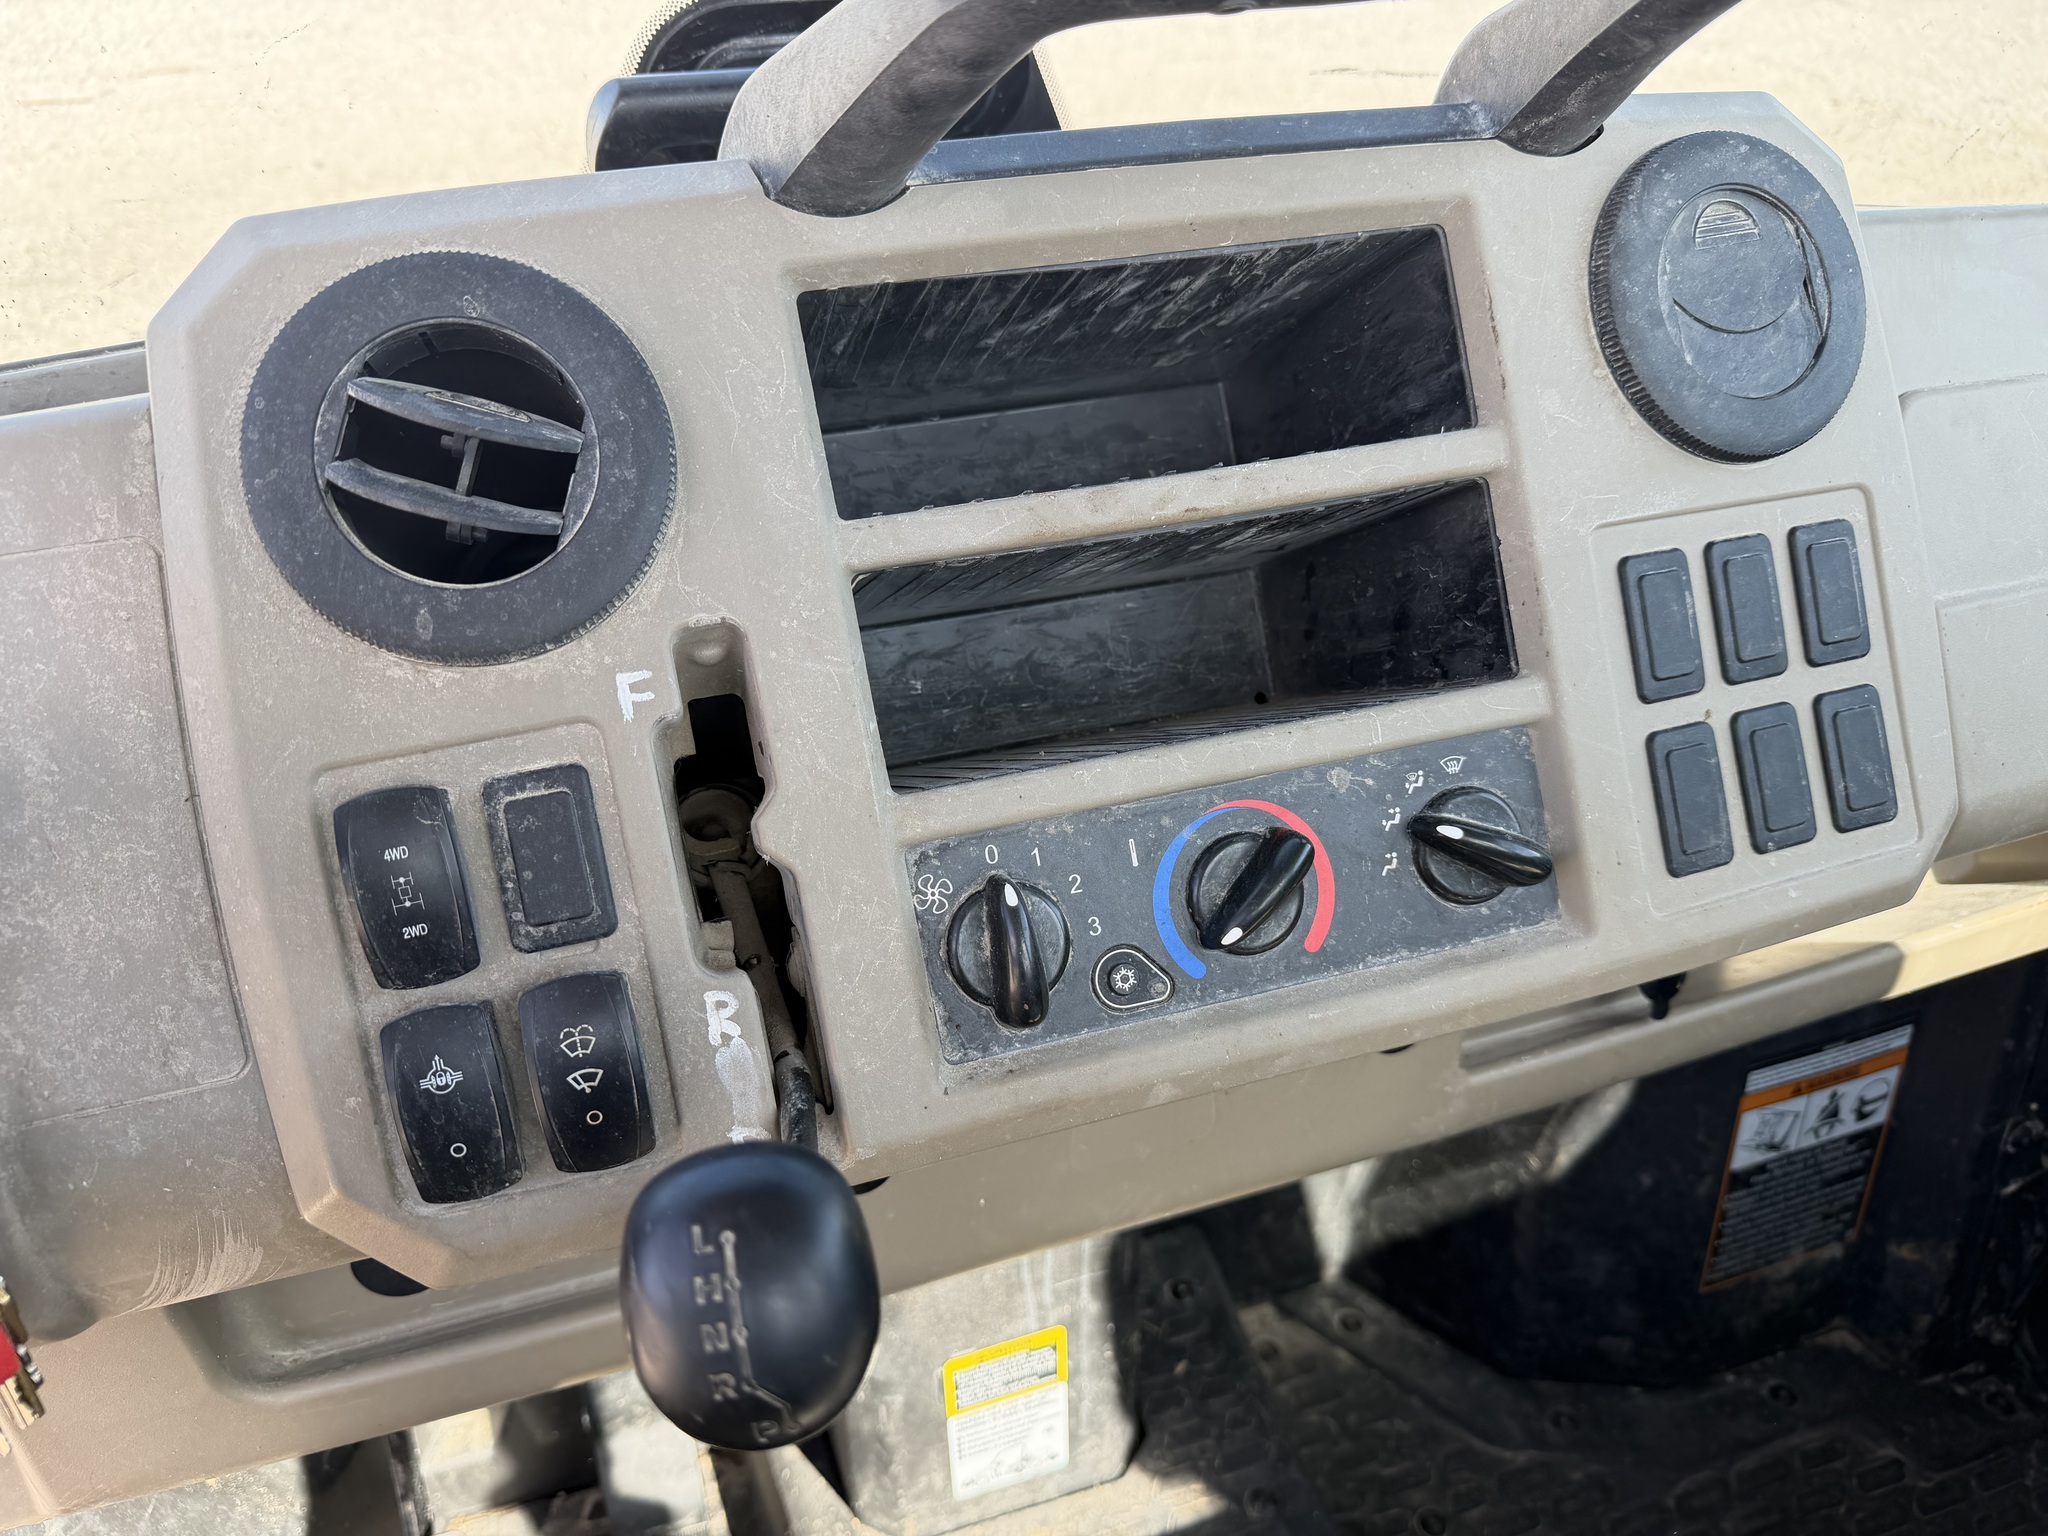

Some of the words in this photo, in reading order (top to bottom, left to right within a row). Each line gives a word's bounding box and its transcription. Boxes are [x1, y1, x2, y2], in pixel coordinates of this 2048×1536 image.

[616, 670, 655, 724] F
[383, 845, 409, 862] 4WD
[1031, 847, 1041, 867] 1
[1068, 874, 1083, 894] 2
[402, 923, 428, 939] 2WD
[1088, 916, 1102, 936] 3
[703, 990, 741, 1046] R
[691, 1225, 716, 1254] L
[693, 1272, 724, 1306] H
[700, 1321, 731, 1353] N
[707, 1372, 739, 1401] R
